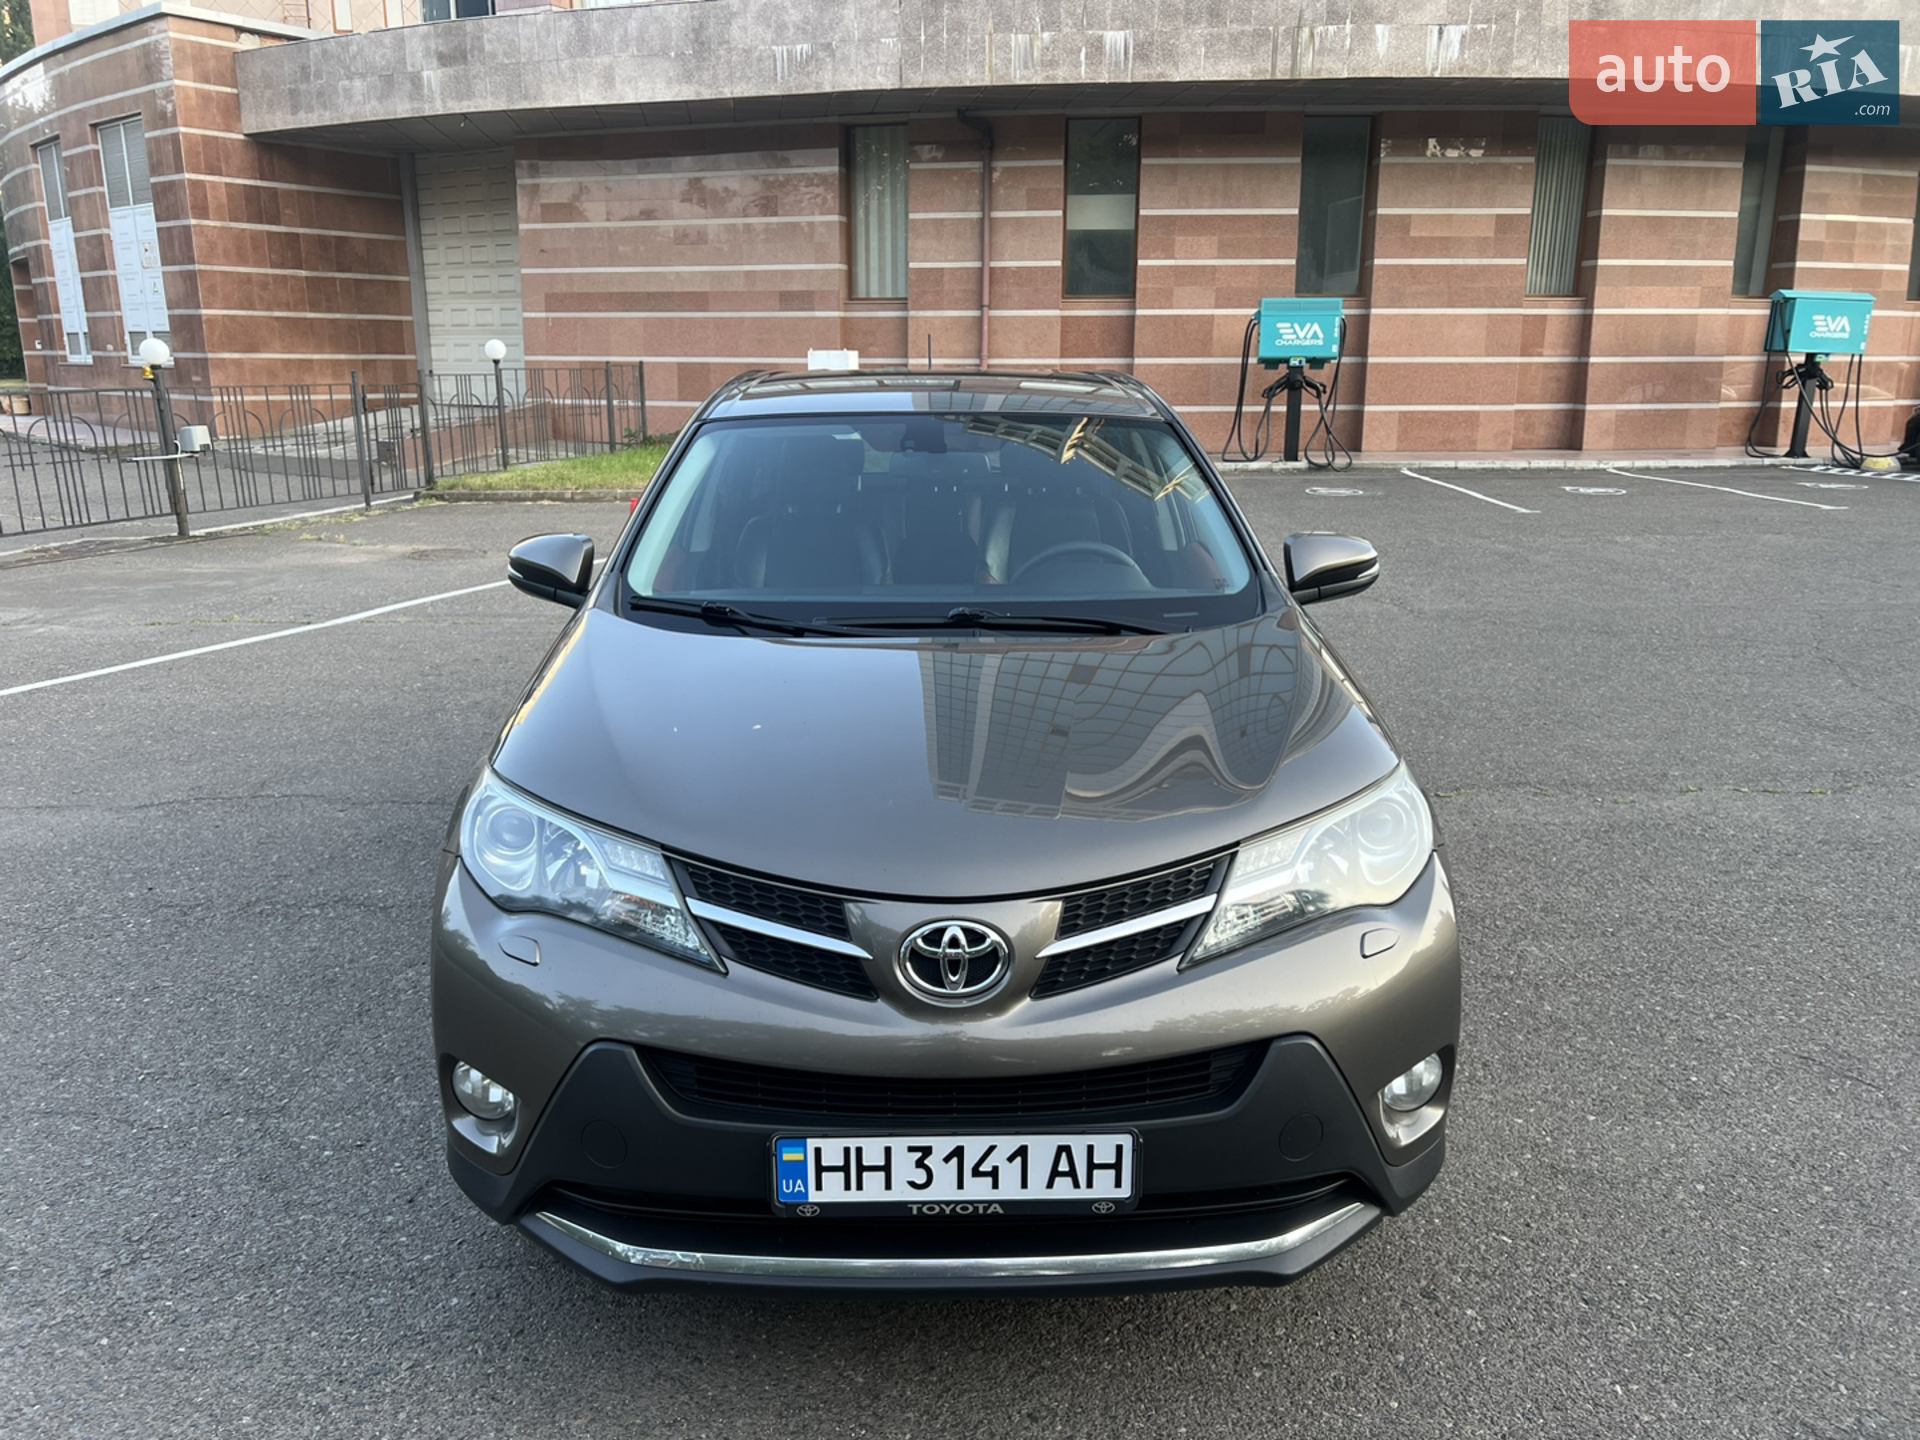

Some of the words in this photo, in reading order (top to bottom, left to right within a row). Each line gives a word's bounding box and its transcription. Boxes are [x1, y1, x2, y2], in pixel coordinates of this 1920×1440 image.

[1276, 322, 1324, 339] EVA
[1812, 315, 1850, 332] EVA
[814, 1146, 892, 1191] HH
[906, 1144, 1029, 1190] 3141
[1045, 1143, 1123, 1190] AH
[782, 1179, 805, 1193] UA
[907, 1203, 1004, 1215] TOYOTA
